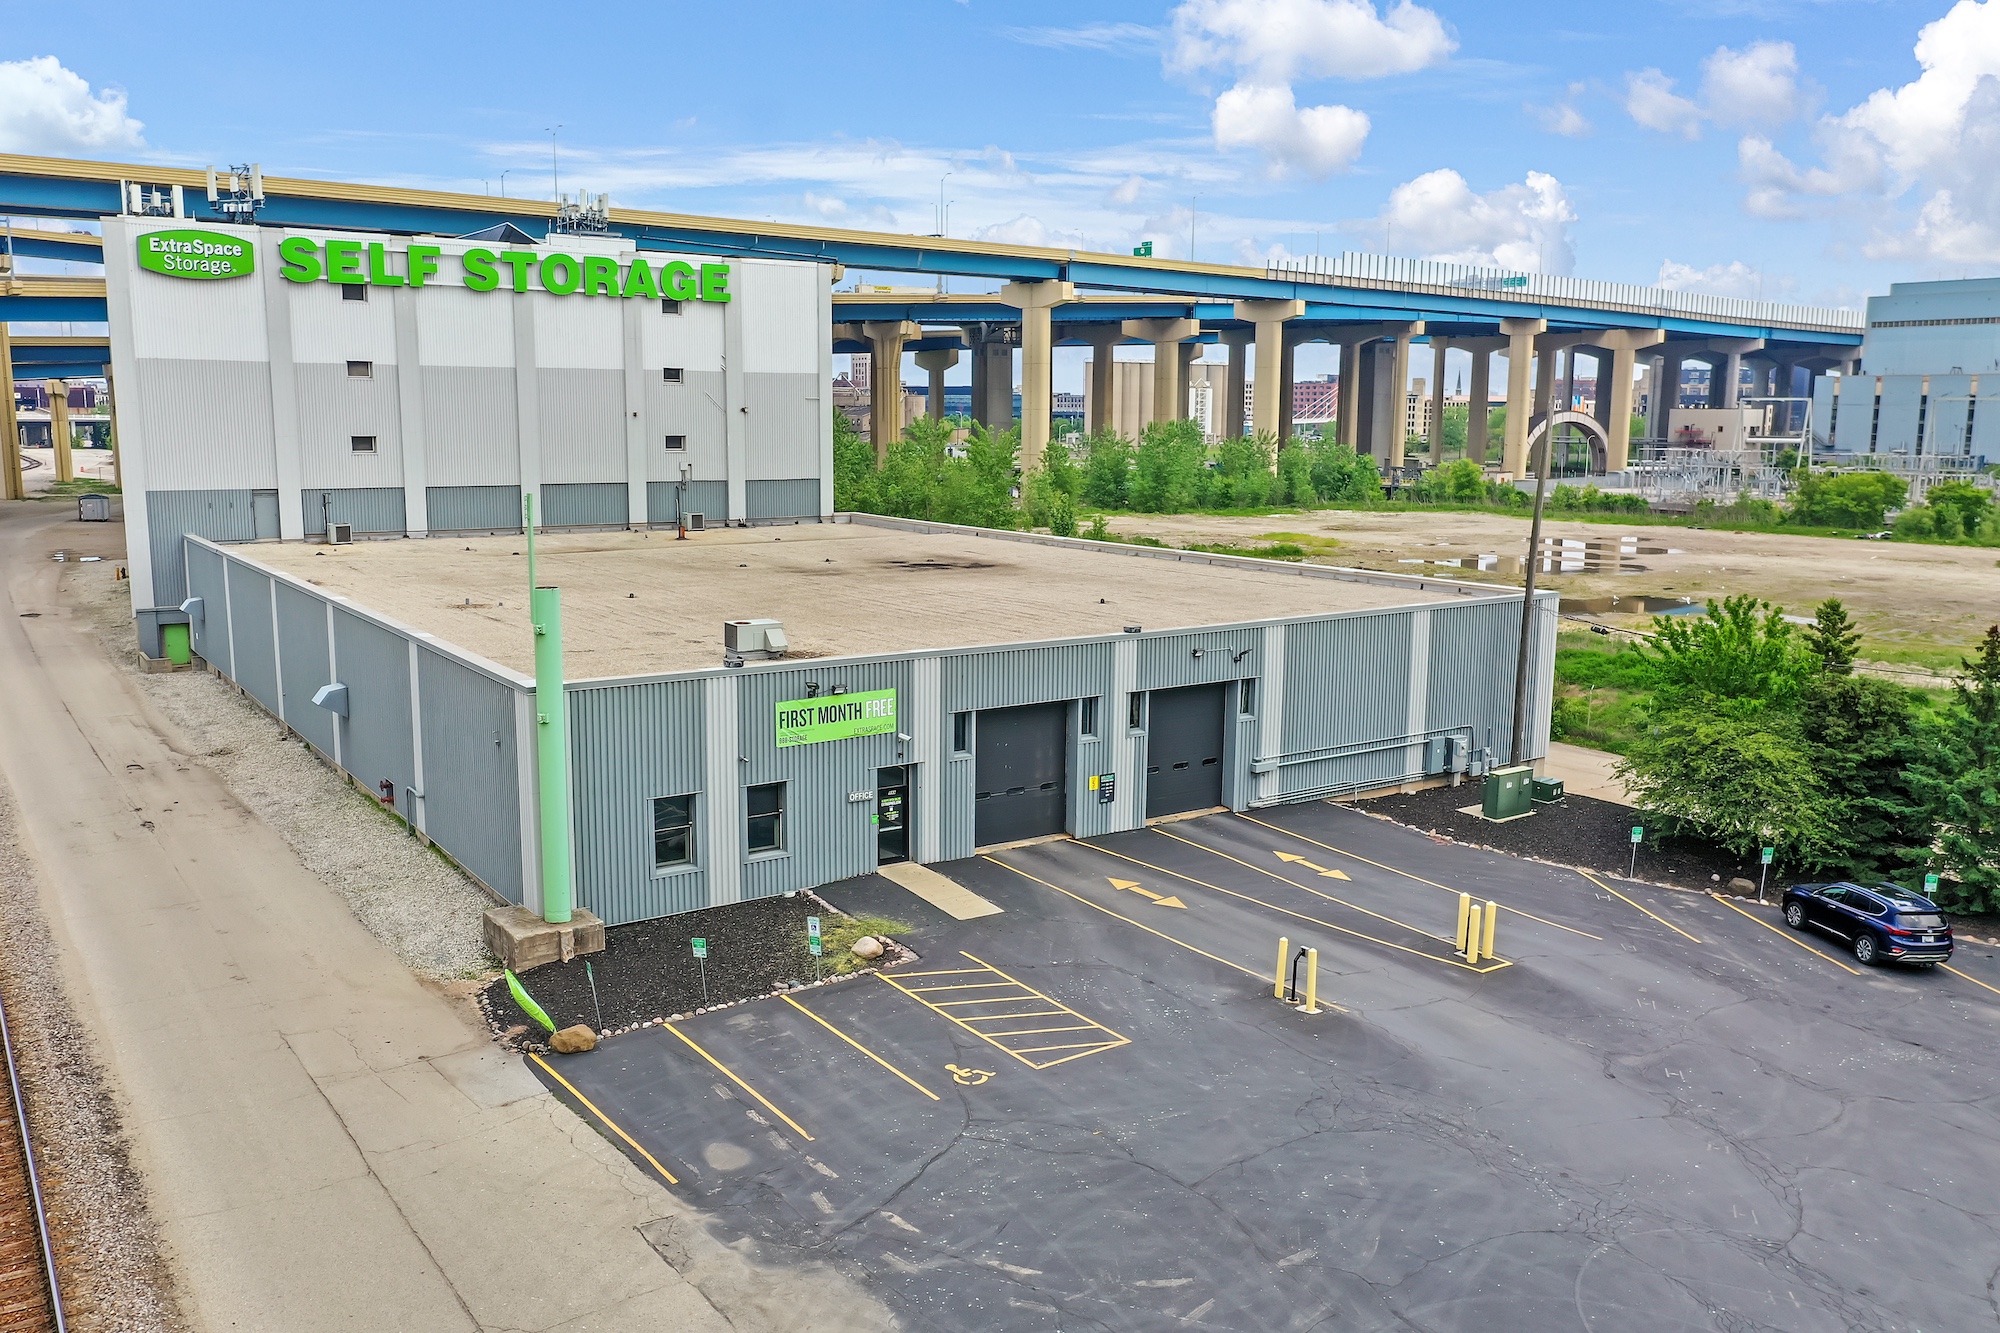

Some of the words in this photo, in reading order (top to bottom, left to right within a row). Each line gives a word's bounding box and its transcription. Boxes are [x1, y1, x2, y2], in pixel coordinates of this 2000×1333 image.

[149, 237, 243, 257] ExtraSpace
[163, 254, 231, 275] Storage
[279, 236, 441, 288] SELF
[463, 248, 731, 303] STORAGE
[779, 707, 815, 730] FIRST
[818, 701, 862, 725] MONTH
[865, 697, 894, 719] FREE
[849, 790, 873, 801] OFFICE
